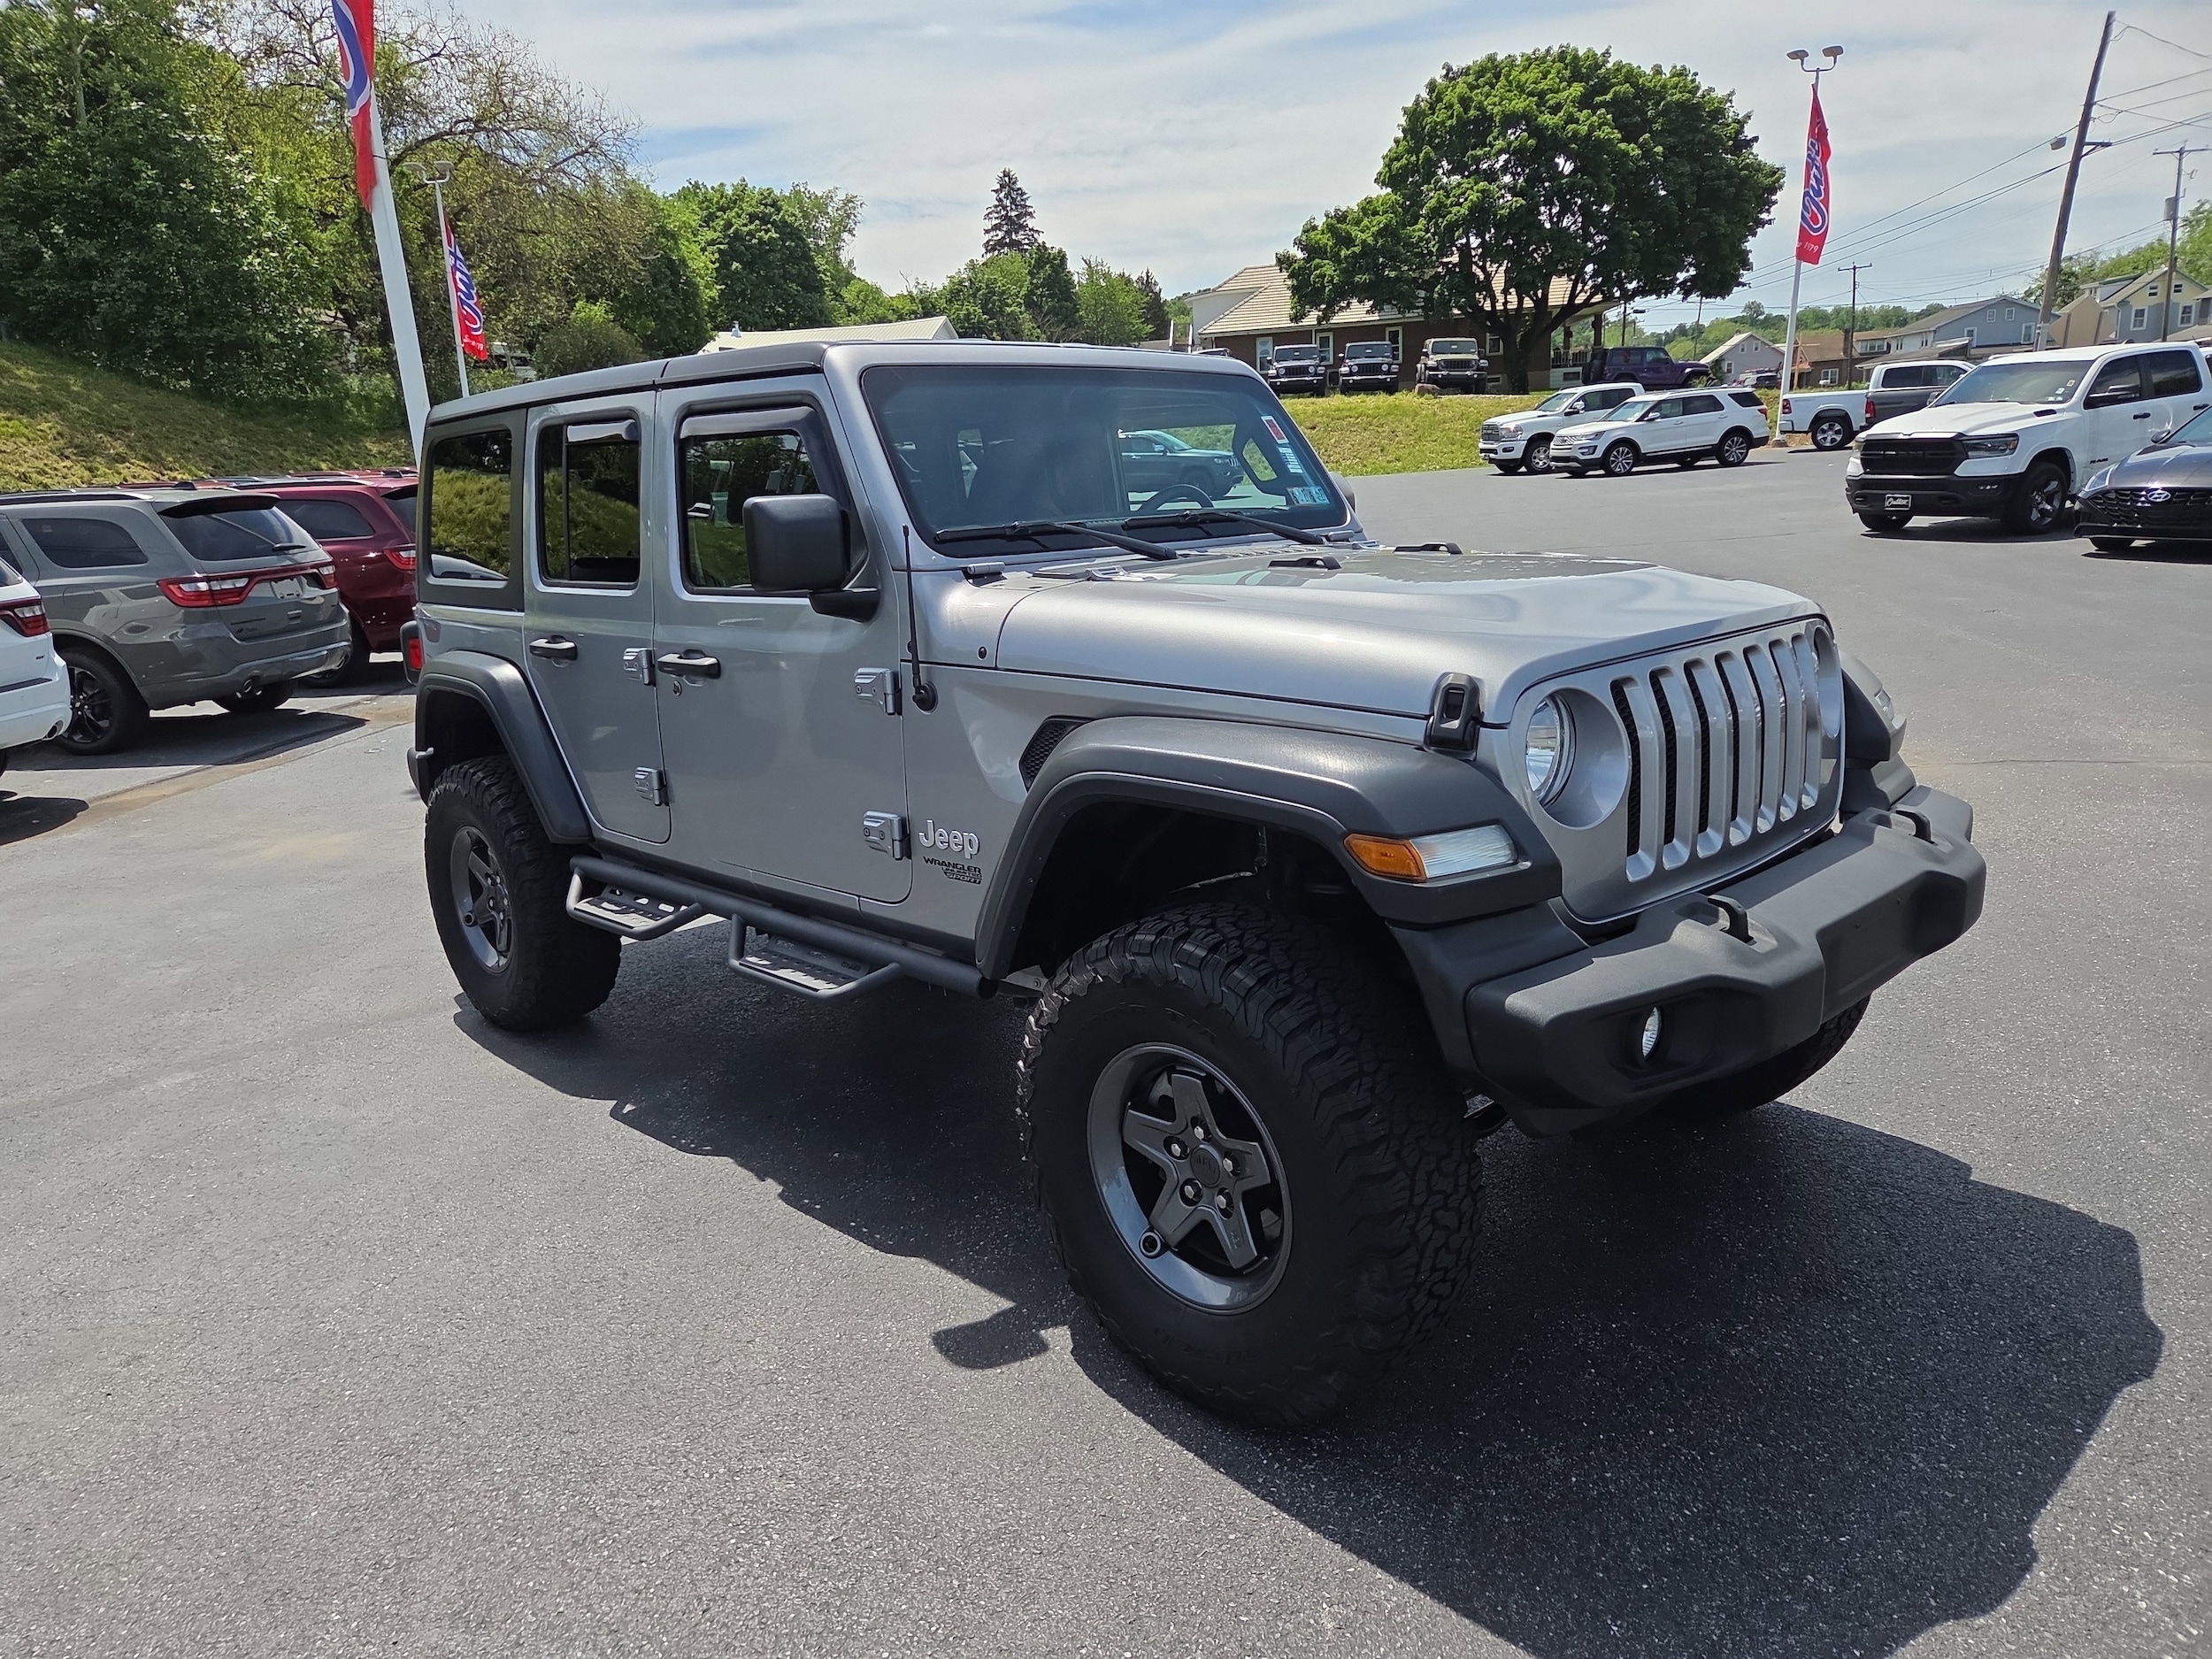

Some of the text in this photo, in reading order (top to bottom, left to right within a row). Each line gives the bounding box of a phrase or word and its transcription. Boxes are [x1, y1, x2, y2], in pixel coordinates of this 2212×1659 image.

[918, 819, 979, 859] Jeep
[923, 856, 981, 874] WRANGLER
[941, 867, 983, 878] UNLIMITED
[946, 872, 982, 884] SPORT
